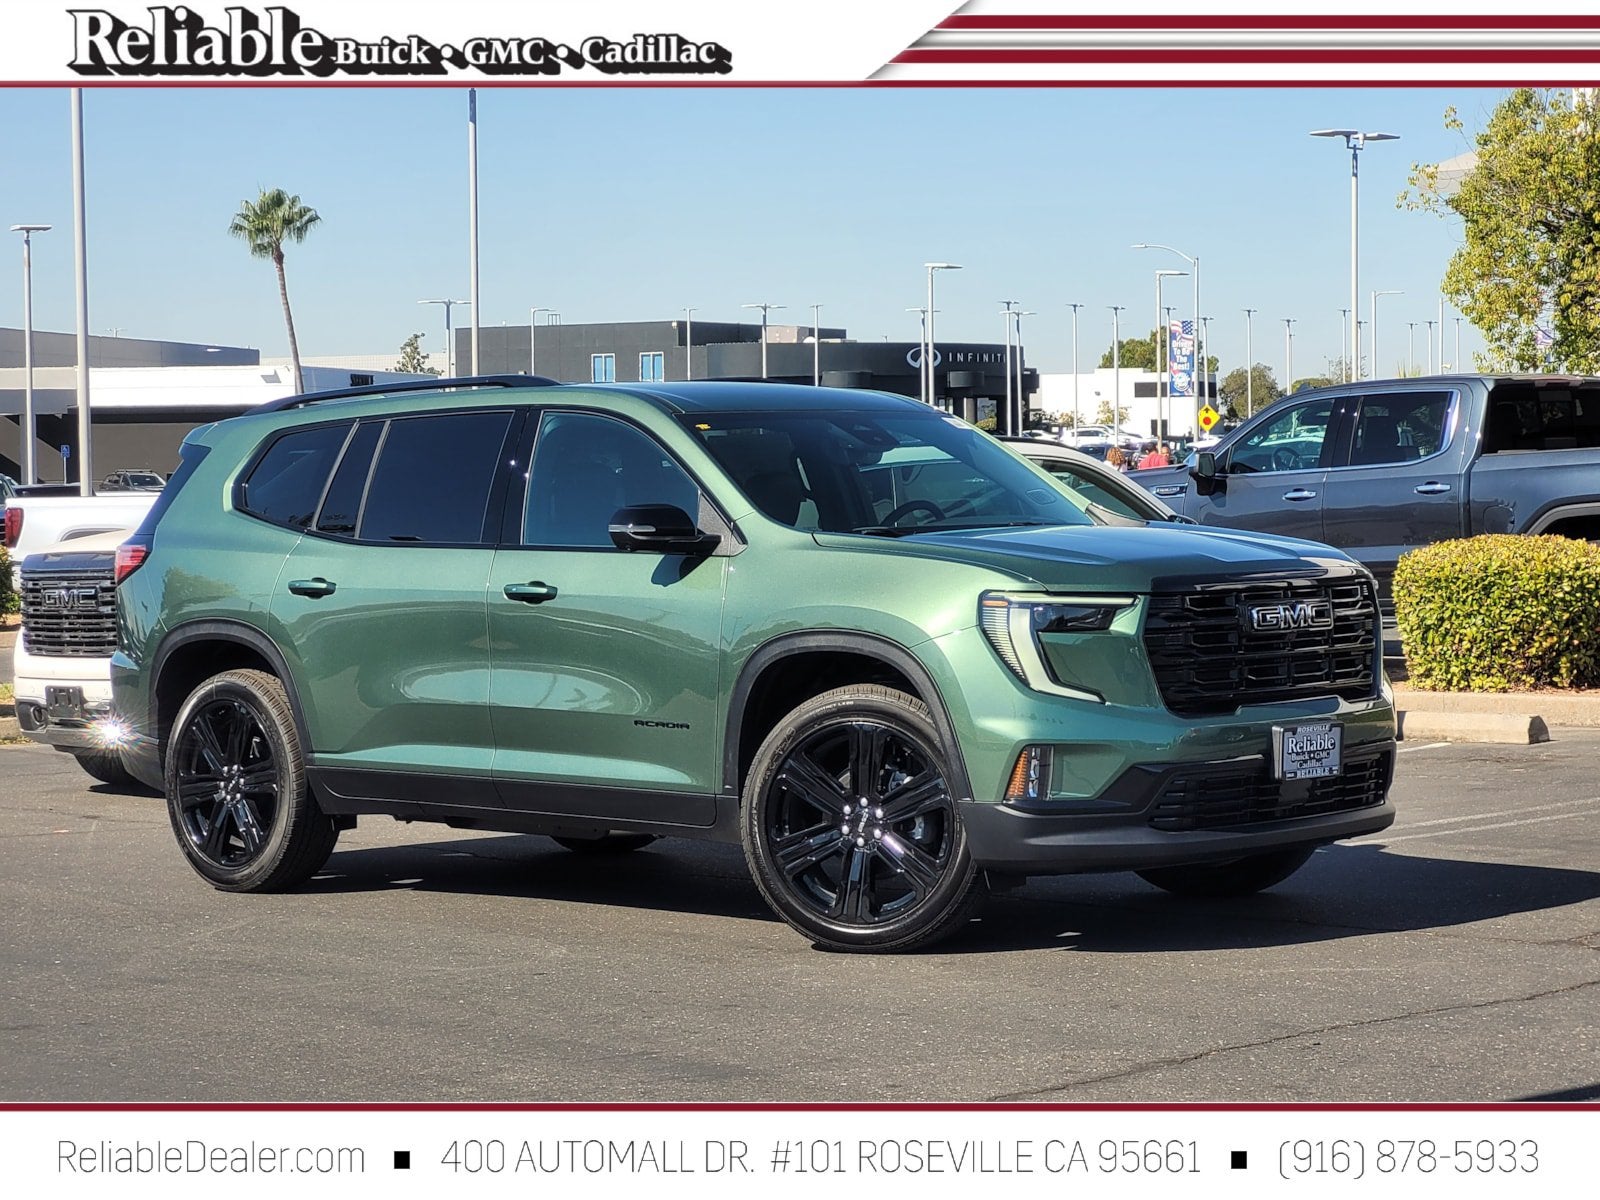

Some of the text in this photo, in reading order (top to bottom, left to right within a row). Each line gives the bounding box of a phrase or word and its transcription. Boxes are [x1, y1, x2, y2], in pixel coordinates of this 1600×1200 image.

[43, 588, 97, 608] GMC
[1251, 601, 1334, 631] GMC
[633, 719, 690, 730] ACADIA
[1297, 724, 1329, 733] ROSEVILLE
[1288, 733, 1335, 753] Reliable
[1314, 750, 1329, 759] GMC
